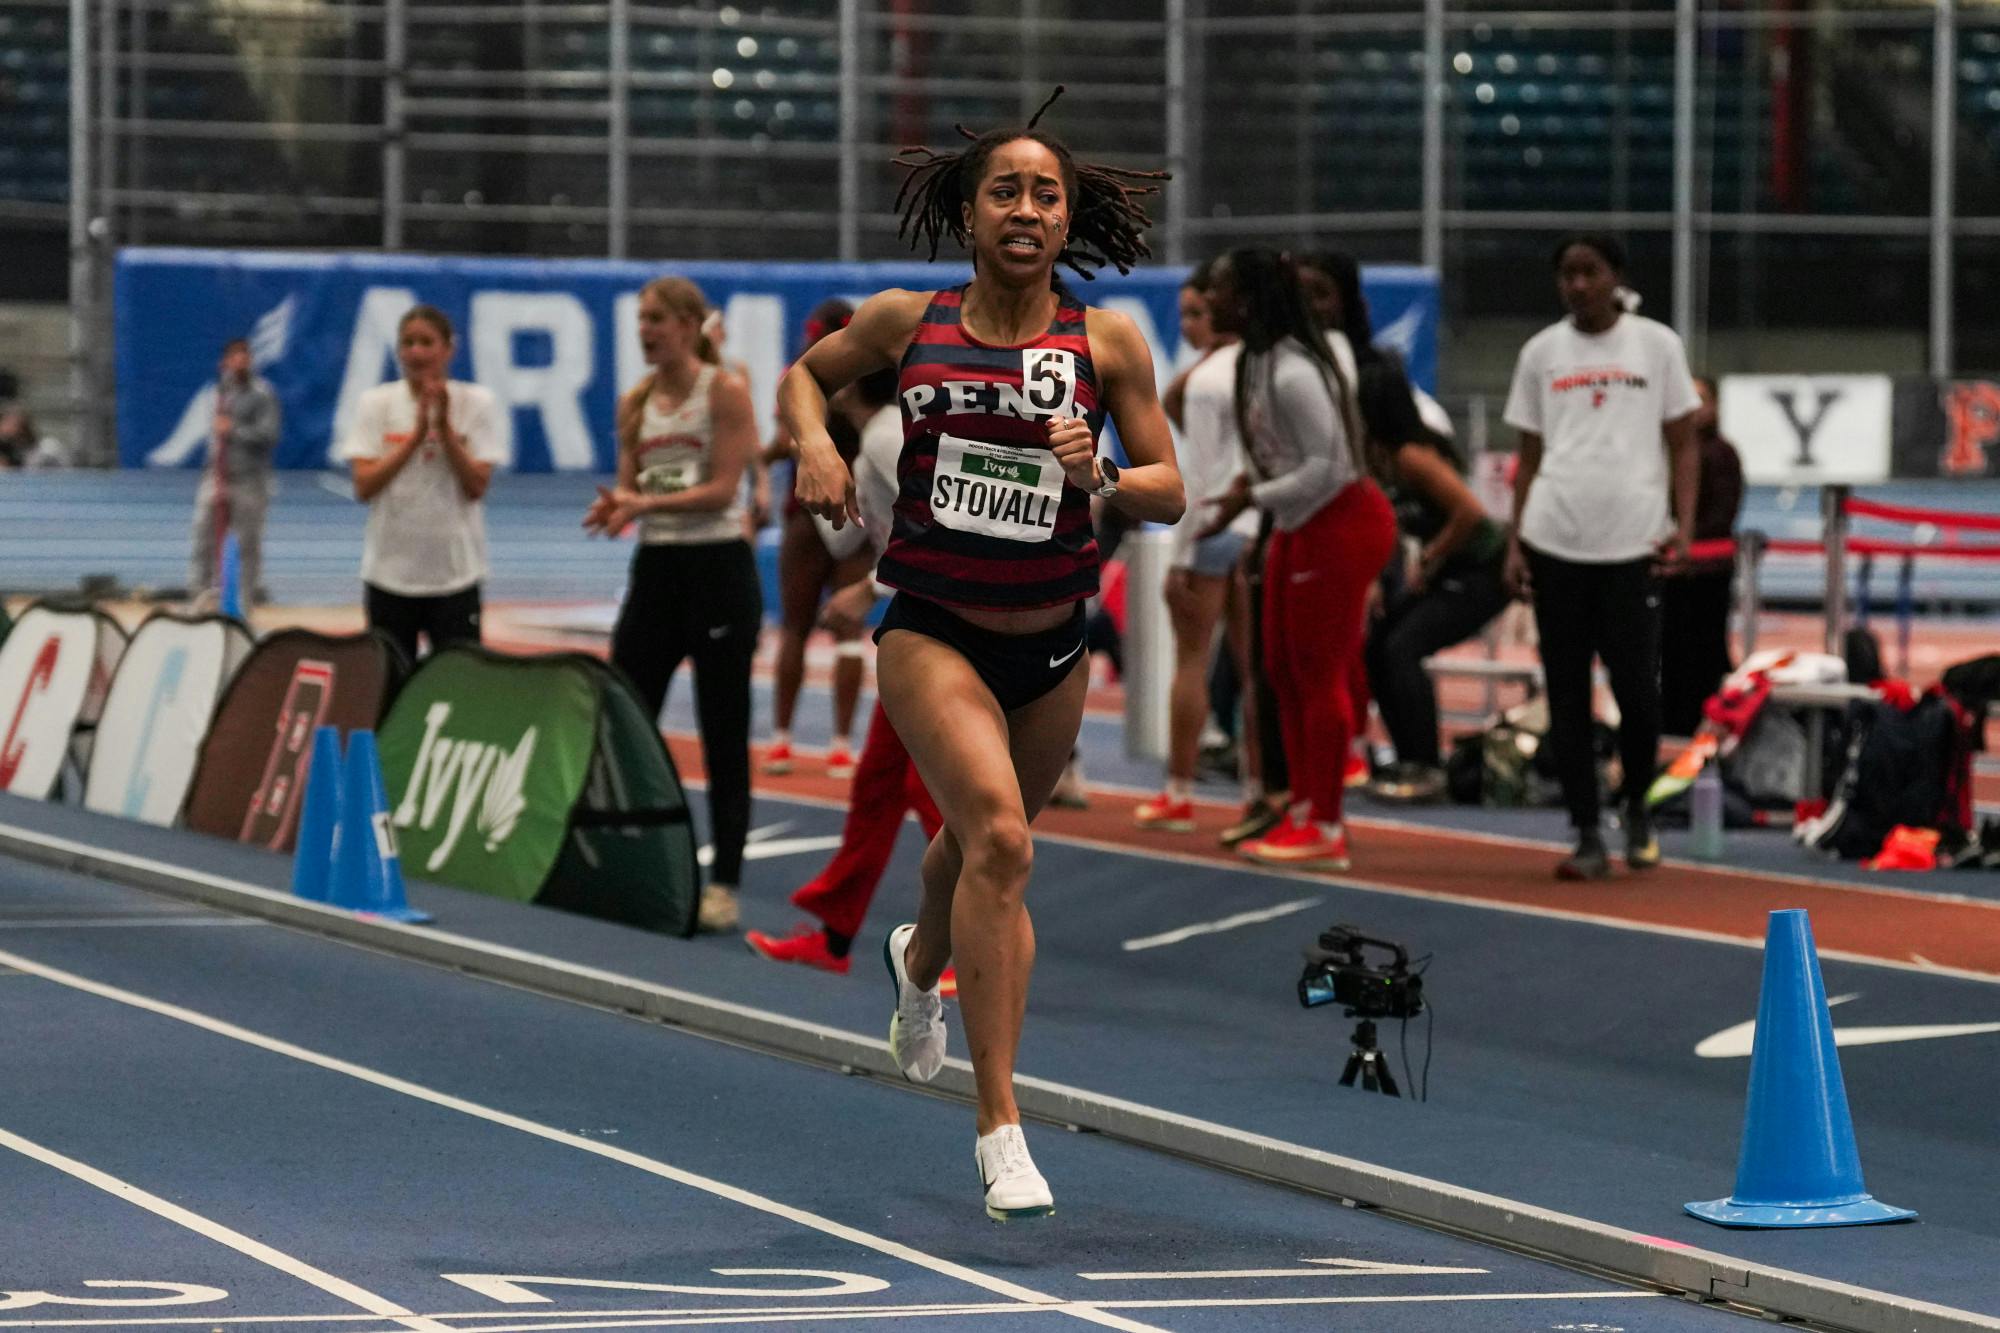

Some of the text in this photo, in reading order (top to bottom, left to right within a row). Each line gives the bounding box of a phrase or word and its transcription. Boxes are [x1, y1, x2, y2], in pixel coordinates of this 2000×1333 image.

[902, 381, 1090, 422] PEN
[1029, 352, 1067, 411] 5
[1770, 388, 1842, 467] Y
[1941, 376, 2000, 475] P
[982, 457, 1008, 478] Ivy
[933, 474, 1053, 529] STOVALL
[391, 701, 499, 872] Ivy
